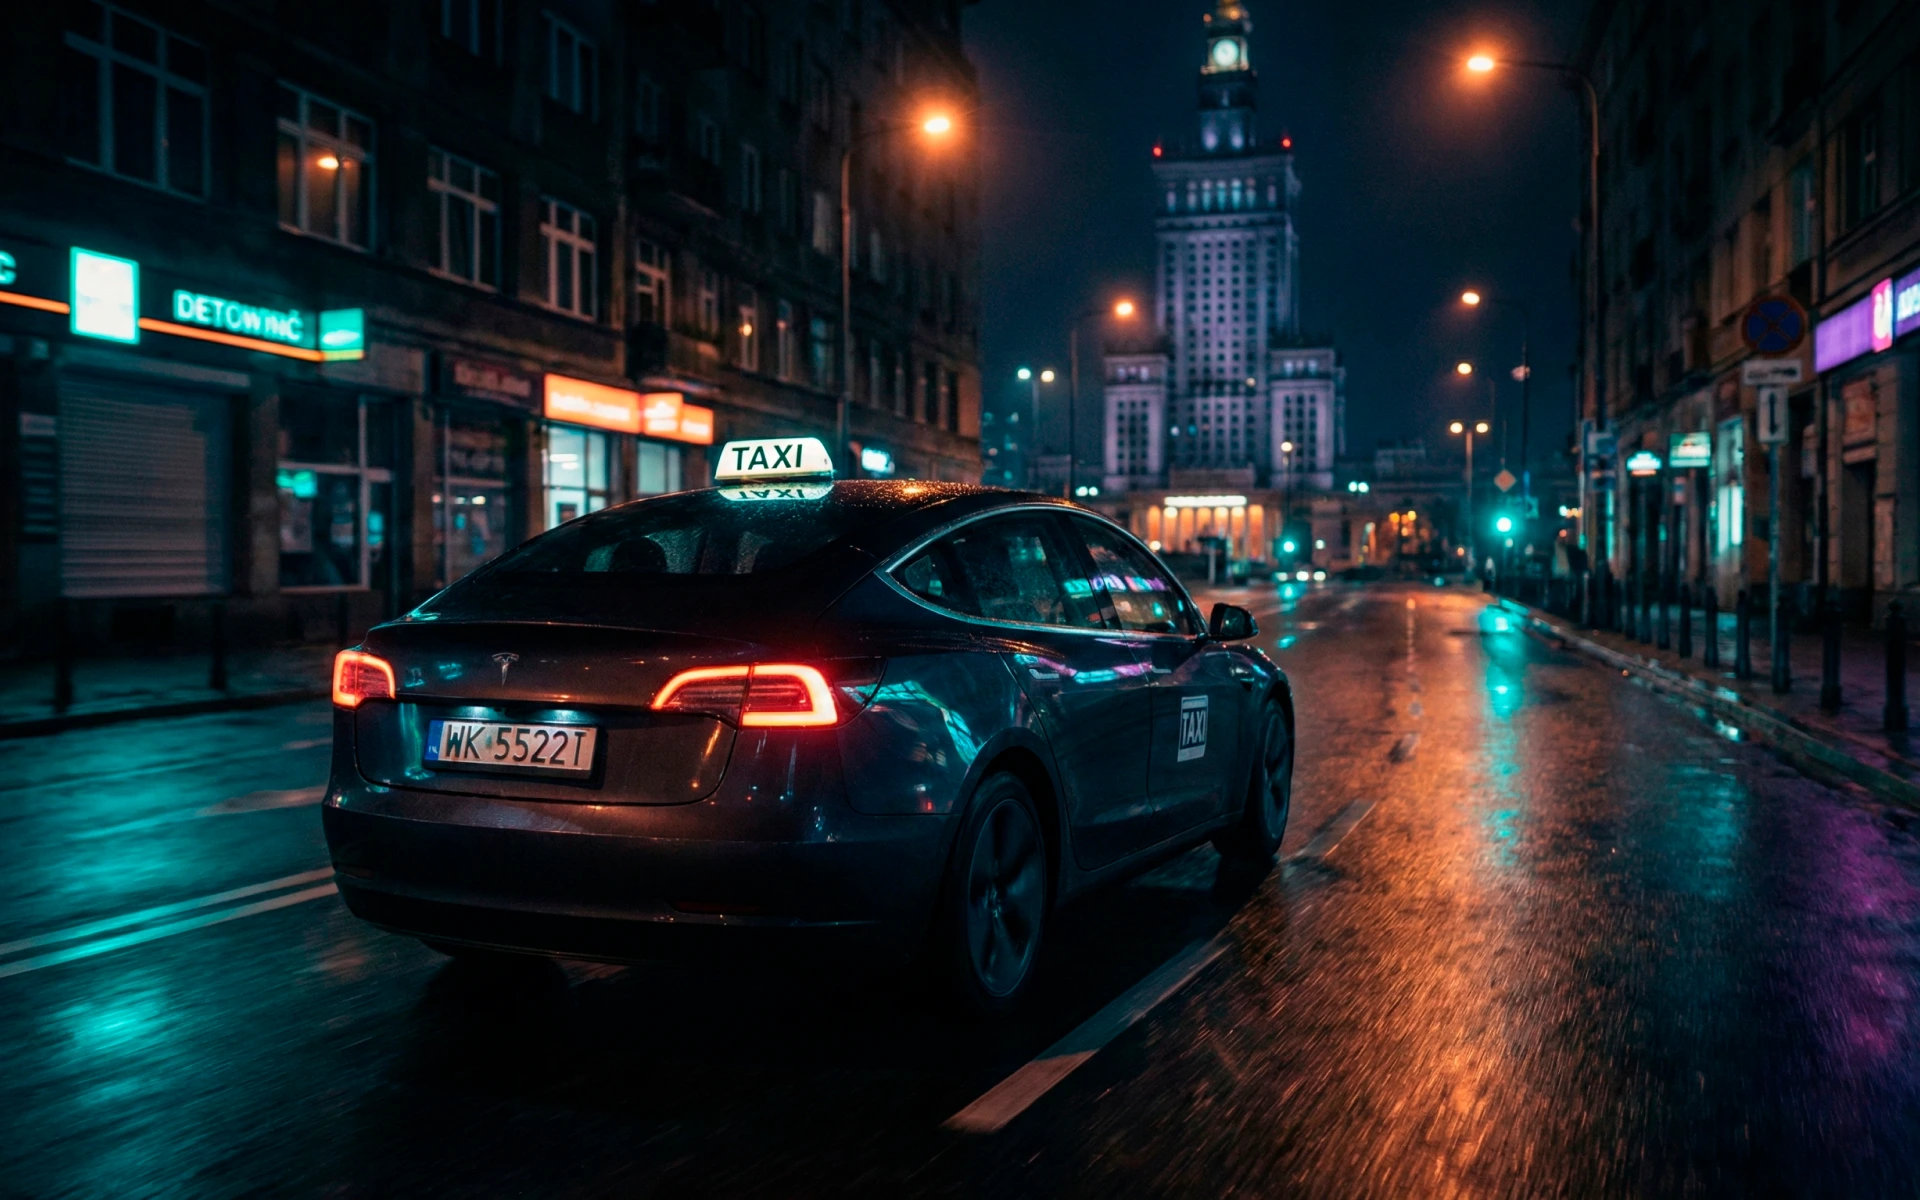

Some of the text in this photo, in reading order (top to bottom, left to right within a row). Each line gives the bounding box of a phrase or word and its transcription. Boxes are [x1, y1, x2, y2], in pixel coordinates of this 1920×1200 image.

[732, 444, 803, 471] TAXI
[445, 724, 587, 766] WK 5522T
[1182, 710, 1206, 747] TAXI
